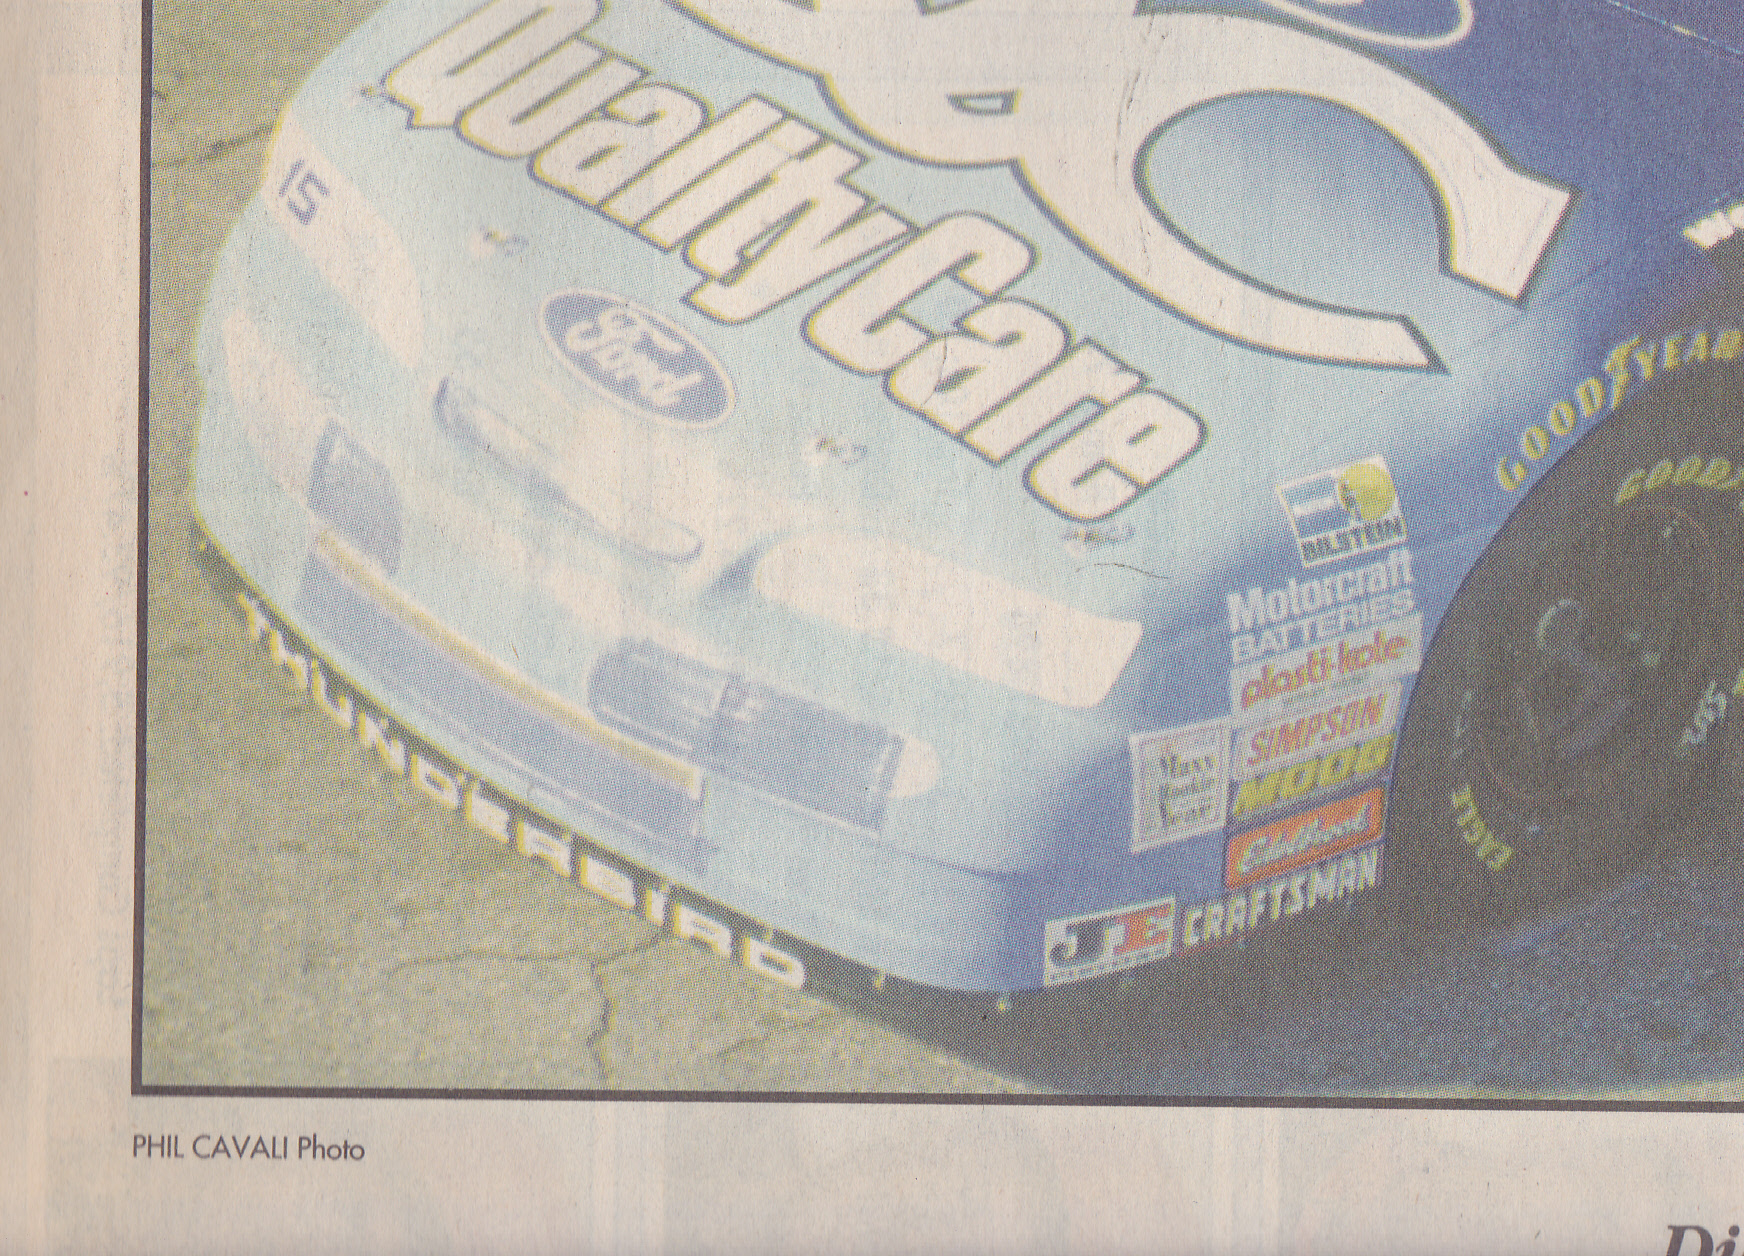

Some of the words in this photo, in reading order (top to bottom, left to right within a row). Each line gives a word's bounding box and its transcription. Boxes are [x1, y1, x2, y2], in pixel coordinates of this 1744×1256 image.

[278, 158, 331, 226] 15
[567, 309, 702, 409] Ford
[1496, 329, 1744, 491] GOODYEAR
[1300, 517, 1403, 564] BILSTEIN
[1226, 548, 1414, 634] Motorcraft
[1232, 588, 1415, 665] BATTERIES
[1247, 690, 1389, 768] SIMPSON
[1232, 732, 1397, 818] MOOG
[1182, 846, 1379, 947] CRAFTSMAN
[132, 1134, 185, 1159] PHIL
[191, 1134, 289, 1160] CAVALI
[298, 1132, 366, 1162] Photo
